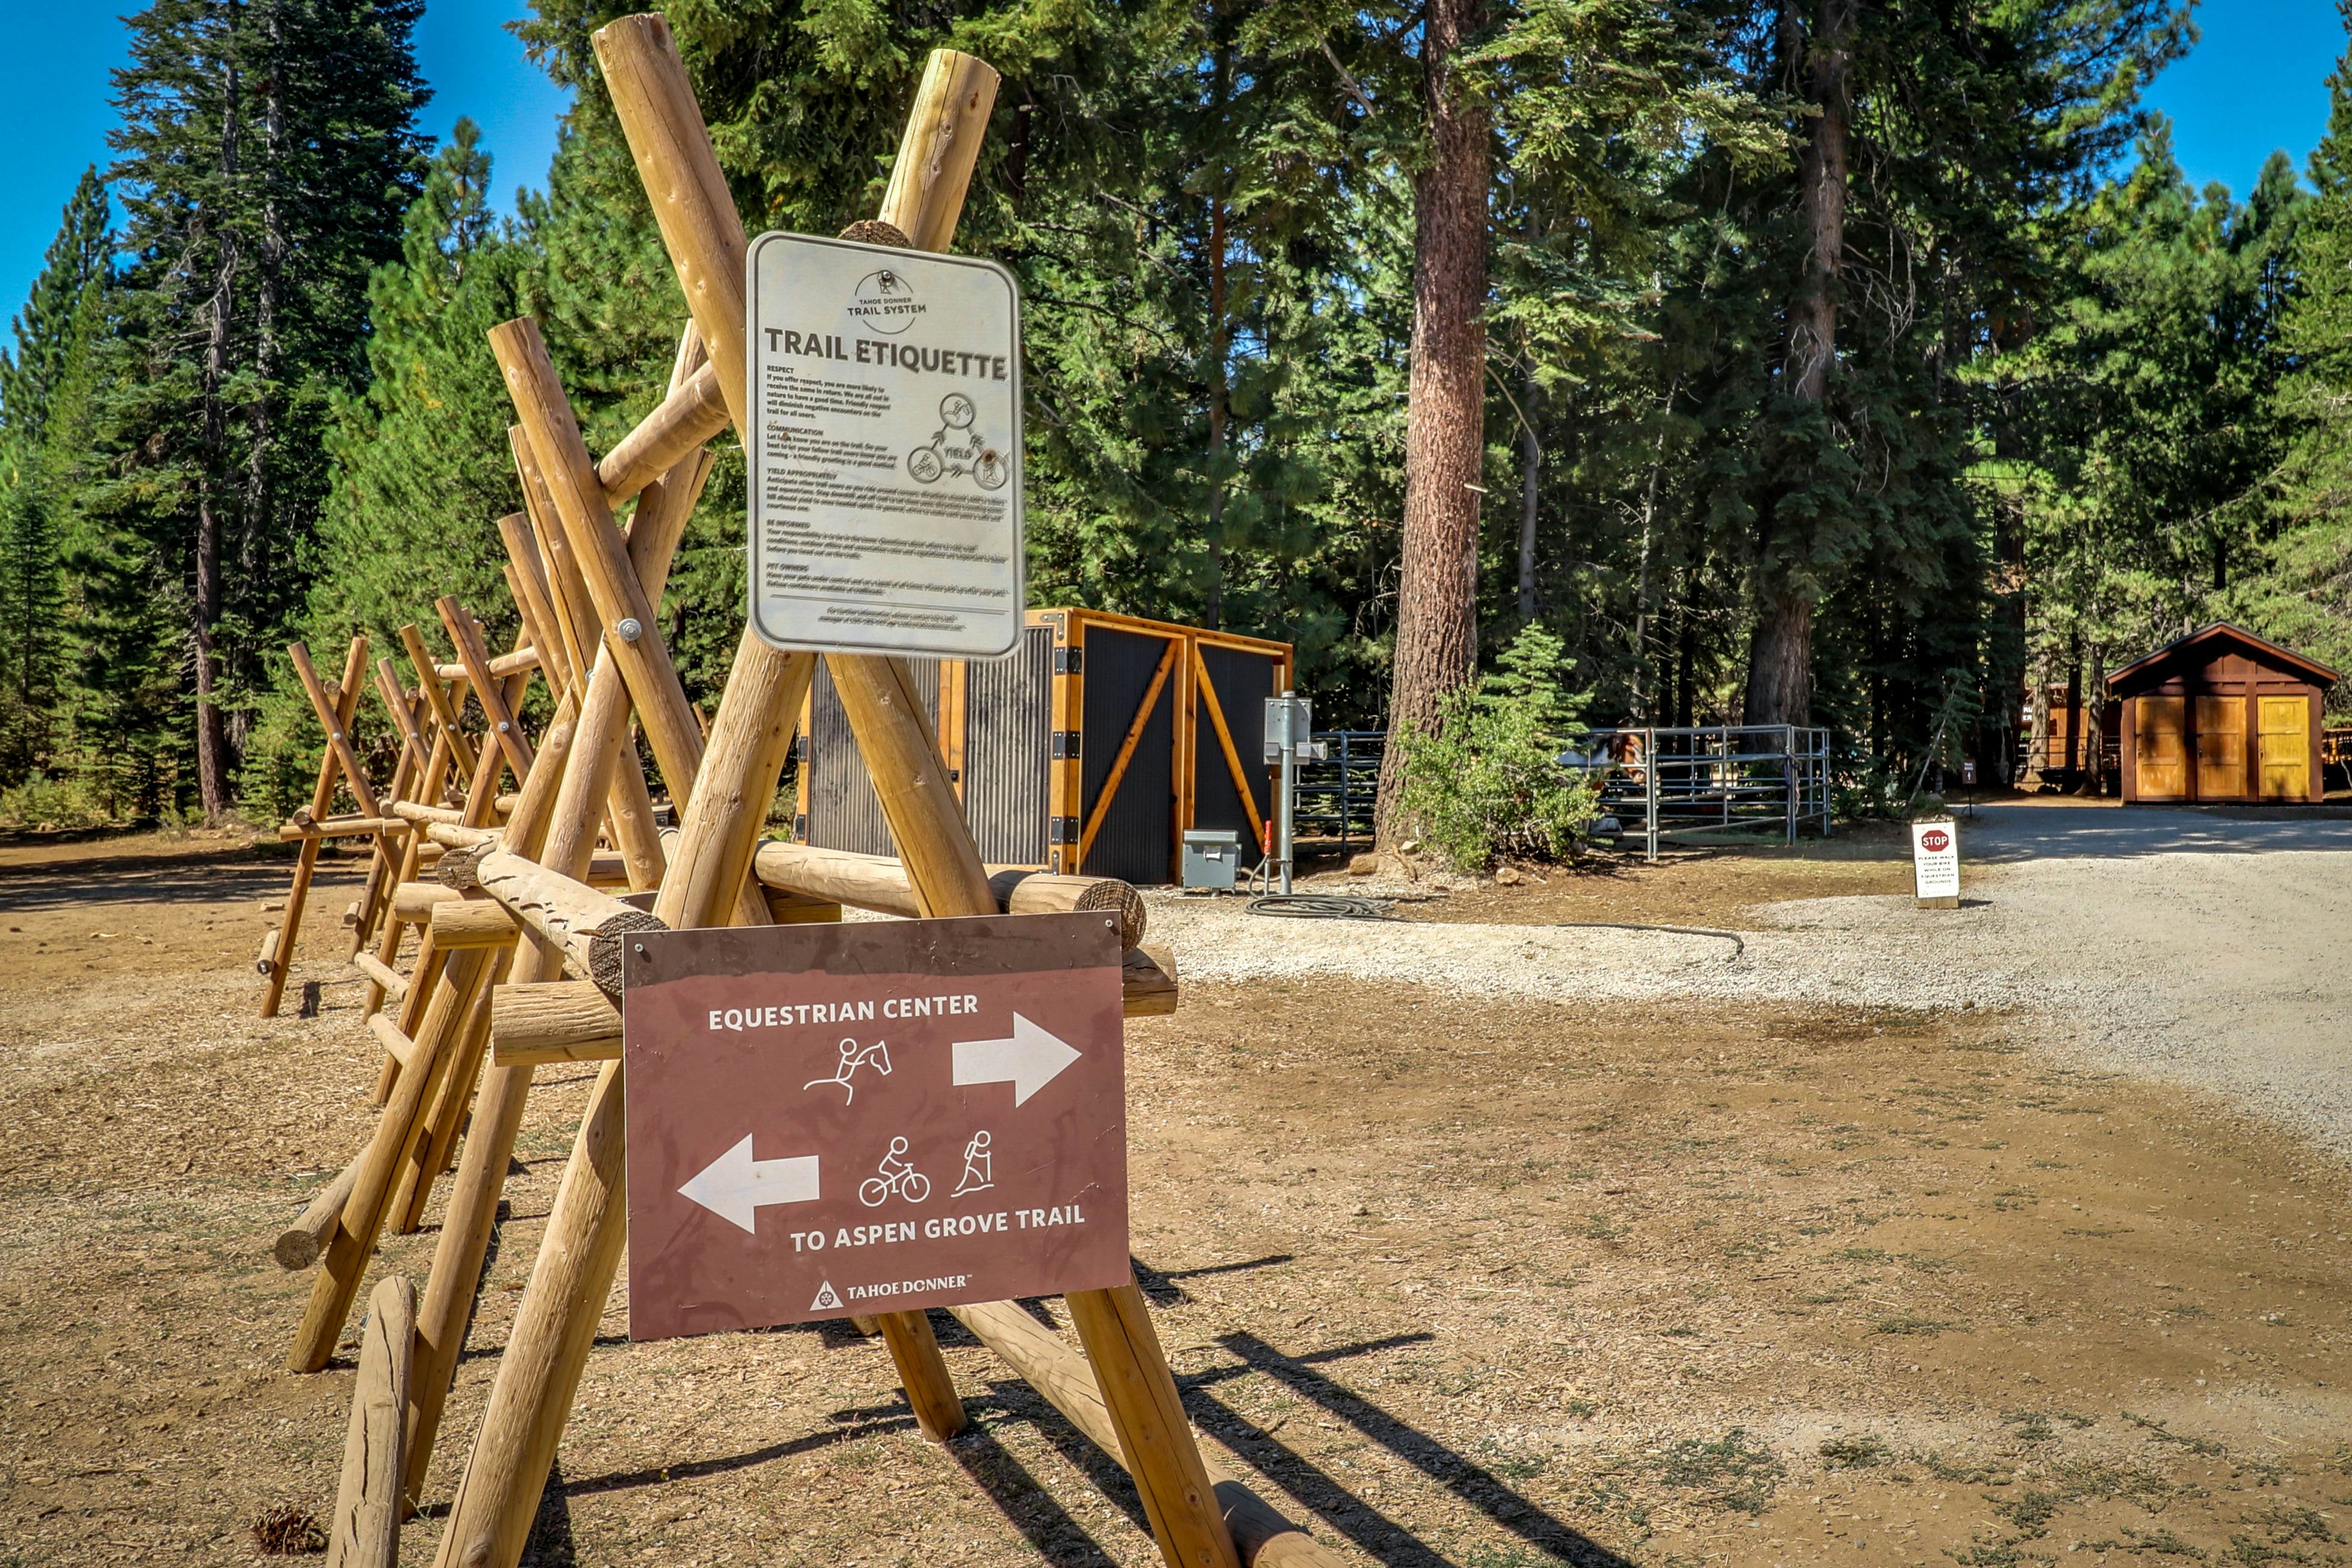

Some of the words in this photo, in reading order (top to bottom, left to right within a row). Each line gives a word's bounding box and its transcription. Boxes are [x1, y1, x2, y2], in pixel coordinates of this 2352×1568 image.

[847, 306, 880, 316] TRAIL
[884, 304, 927, 315] SYSTEM
[765, 327, 848, 361] TRAIL
[856, 339, 1008, 381] ETIQUETTE
[800, 378, 823, 387] respect,
[805, 404, 829, 413] negative
[767, 425, 823, 435] COMMUNICATION
[1923, 836, 1948, 846] STOP
[709, 1001, 874, 1032] EQUESTRIAN
[883, 994, 978, 1019] CENTER
[791, 1232, 825, 1253] TO
[833, 1221, 916, 1249] ASPEN
[924, 1212, 1008, 1238] GROVE
[1016, 1206, 1085, 1230] TRAIL
[847, 1283, 900, 1299] TAHOE
